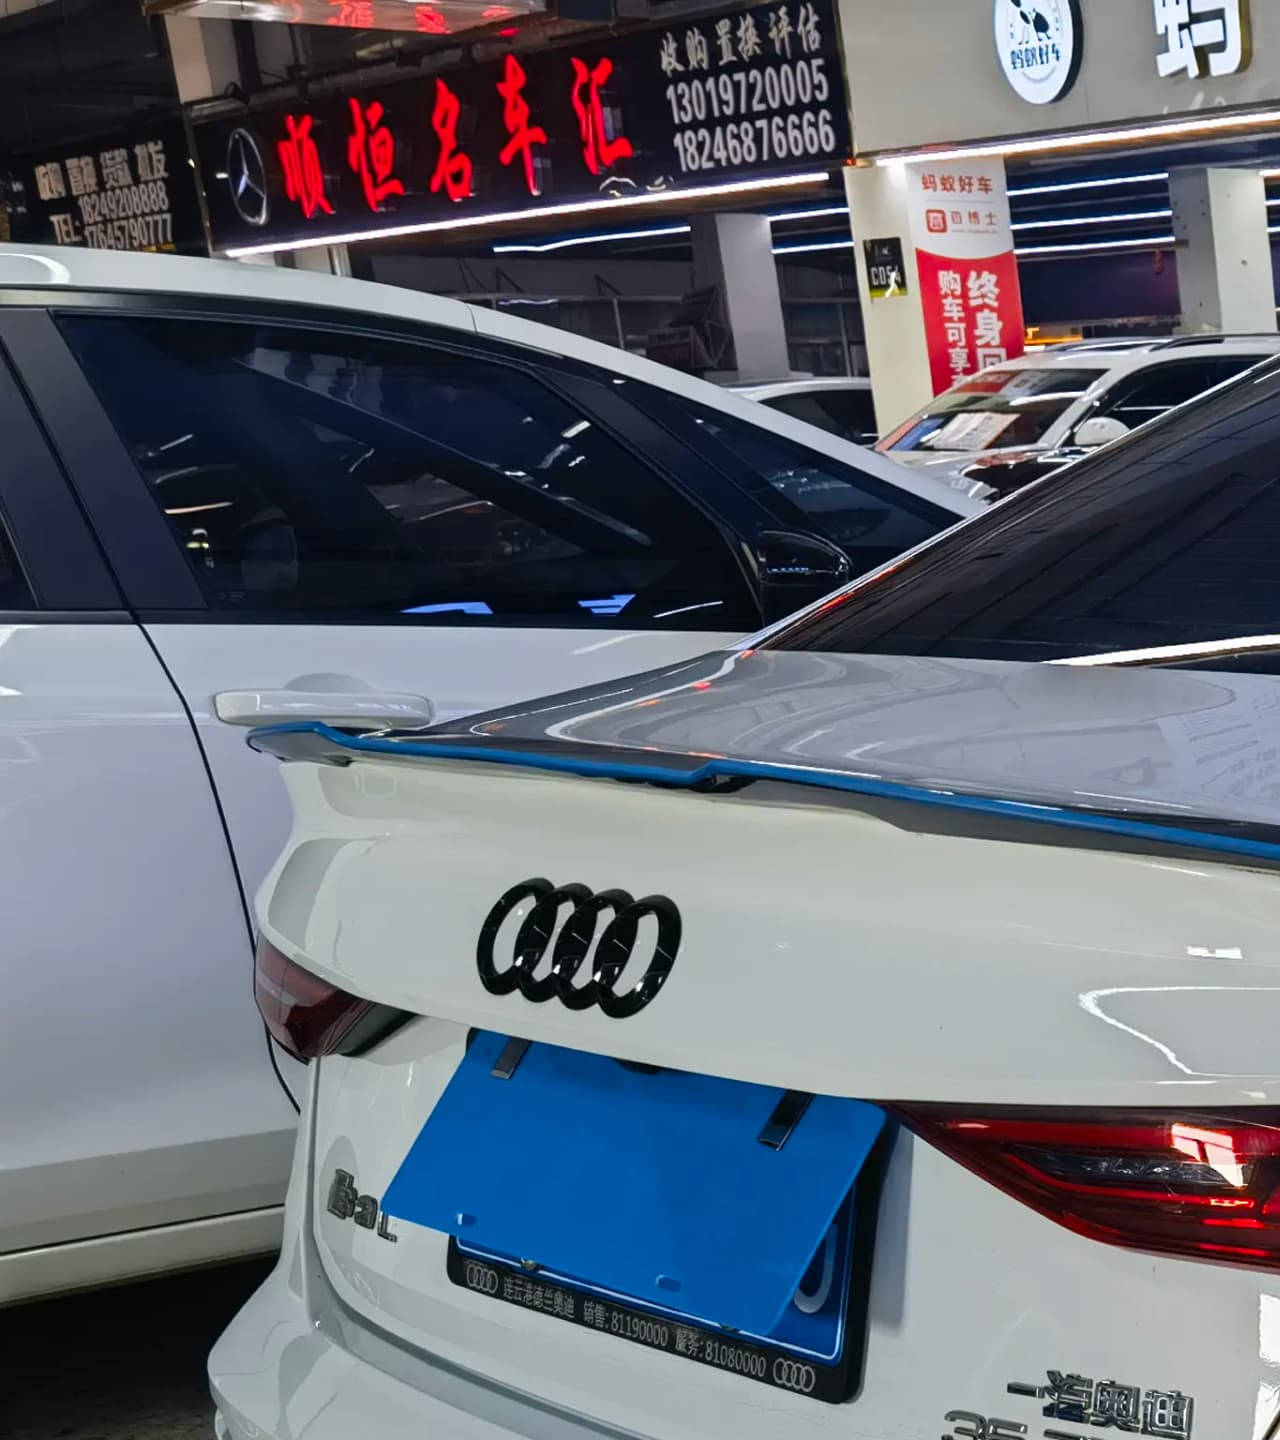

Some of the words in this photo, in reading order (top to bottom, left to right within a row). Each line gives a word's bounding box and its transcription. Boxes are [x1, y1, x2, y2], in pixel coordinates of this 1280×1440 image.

[666, 57, 830, 125] 13019720005
[277, 53, 634, 220] 顺恒名车汇
[673, 108, 837, 173] 18246876666
[921, 173, 994, 195] 蚂蚁好车
[1006, 1370, 1195, 1440] 一汽奥迪
